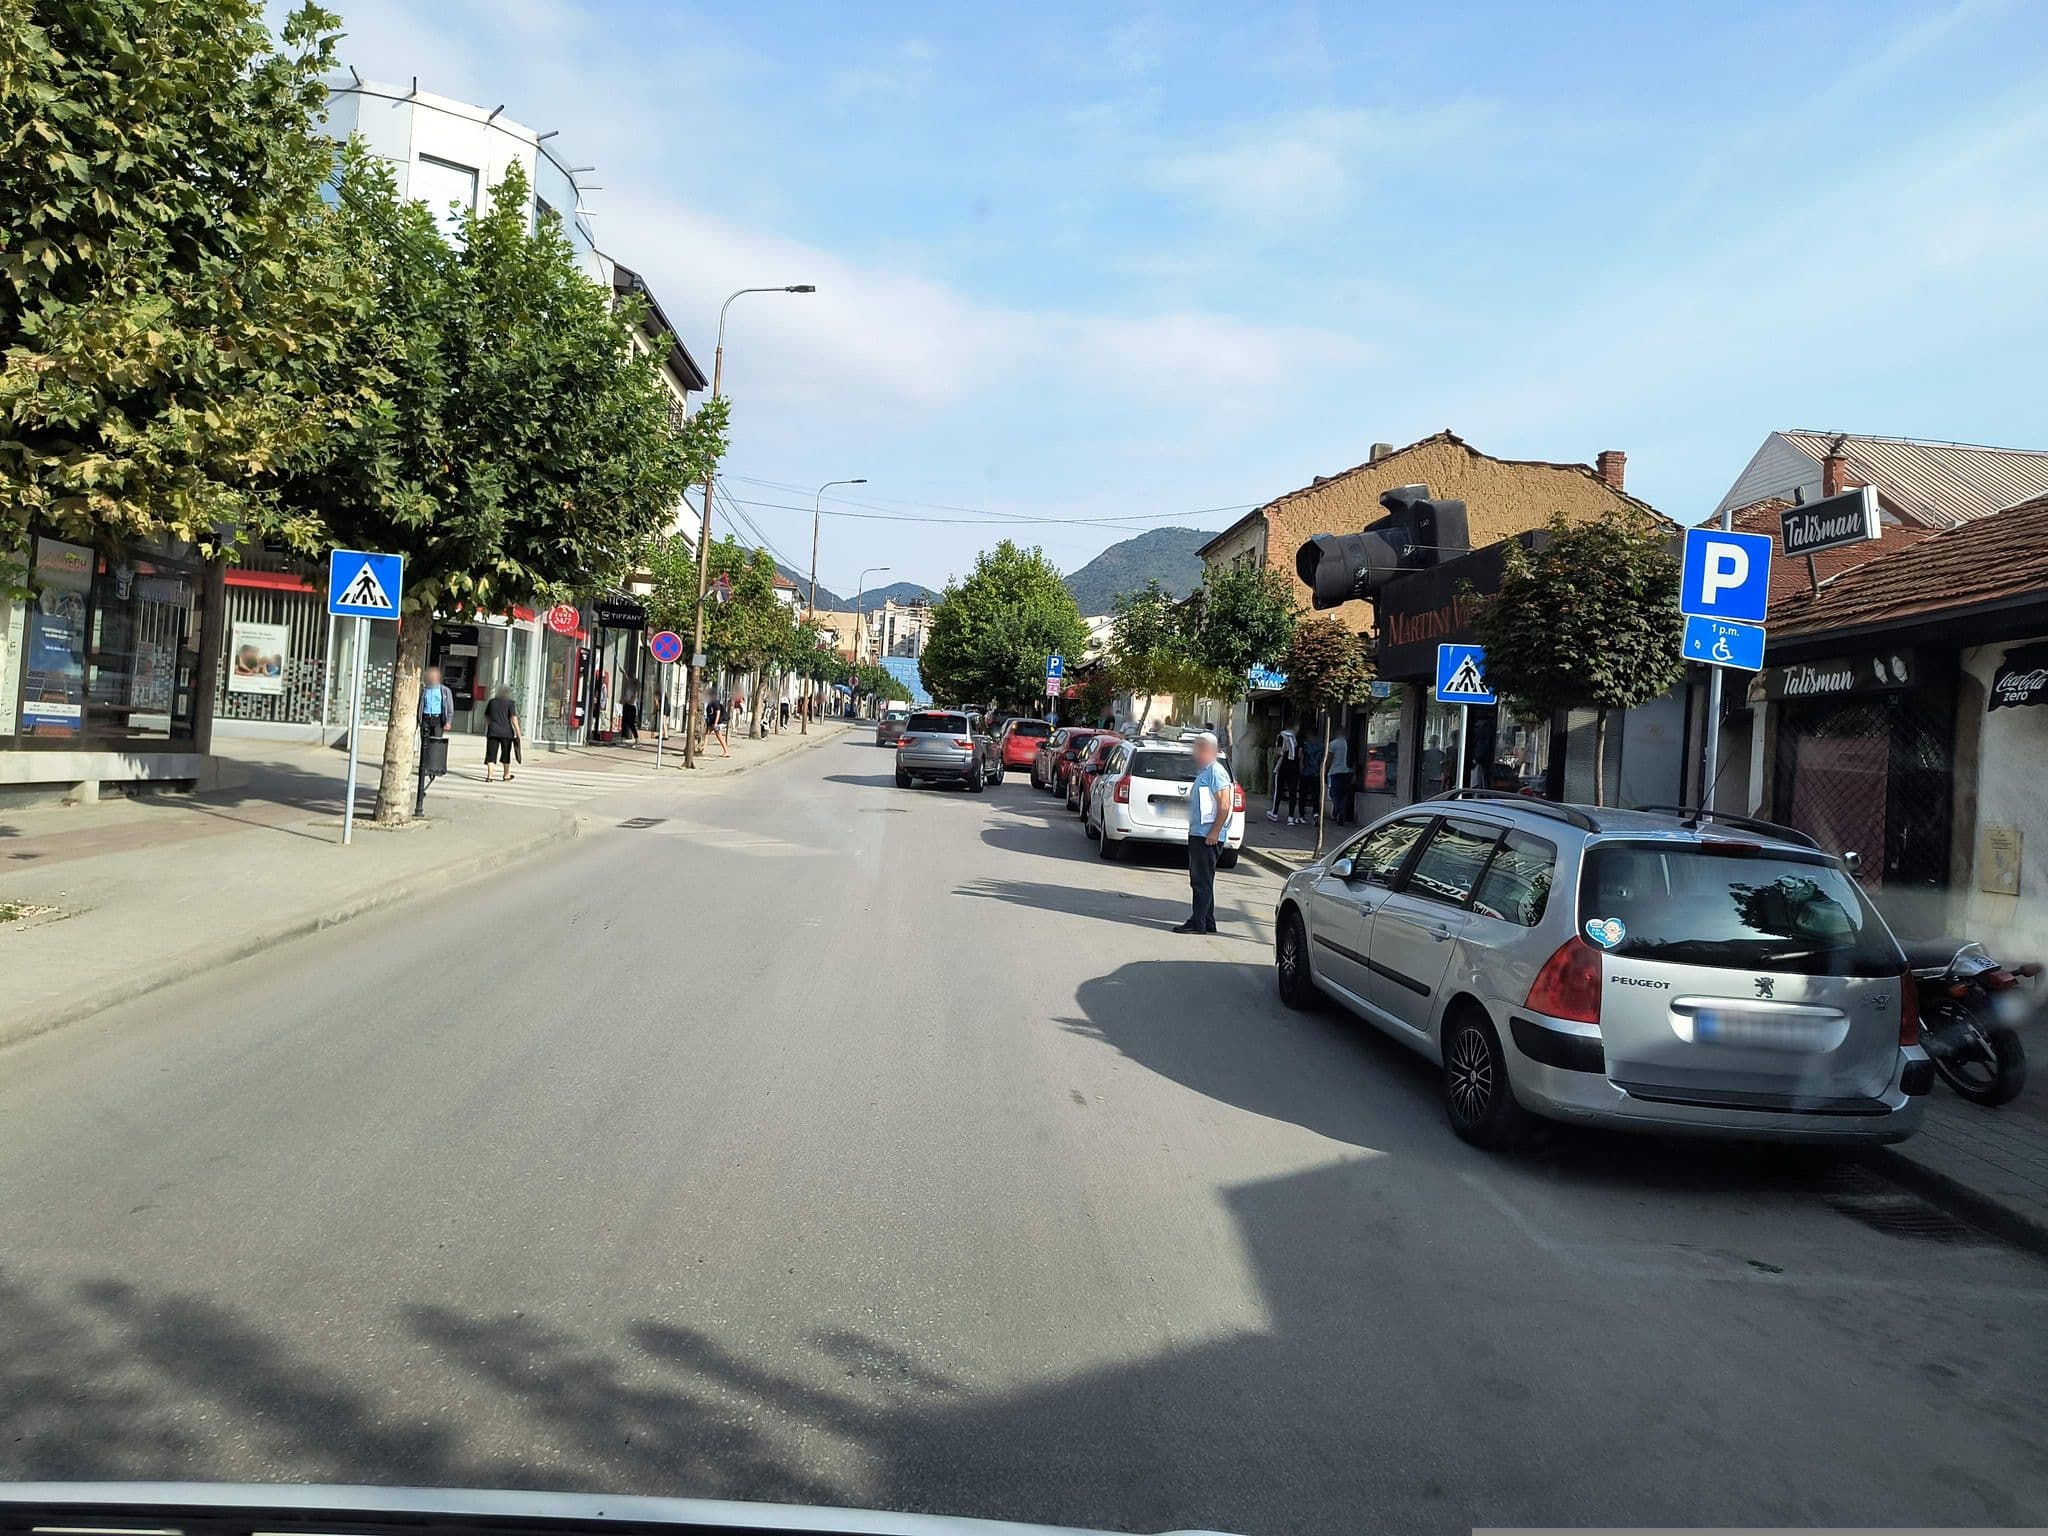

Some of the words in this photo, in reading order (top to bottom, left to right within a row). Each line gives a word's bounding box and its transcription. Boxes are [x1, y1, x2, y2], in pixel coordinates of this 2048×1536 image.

[1785, 512, 1862, 548] Talisman
[1701, 541, 1750, 604] P
[554, 617, 572, 625] 24/7
[611, 613, 642, 621] TIFFANY
[1711, 623, 1718, 633] 1
[1719, 626, 1740, 637] p.m.
[1050, 657, 1060, 669] P
[1782, 665, 1855, 695] Talisman
[2003, 691, 2028, 702] zero
[1611, 976, 1671, 989] PEUGEOT
